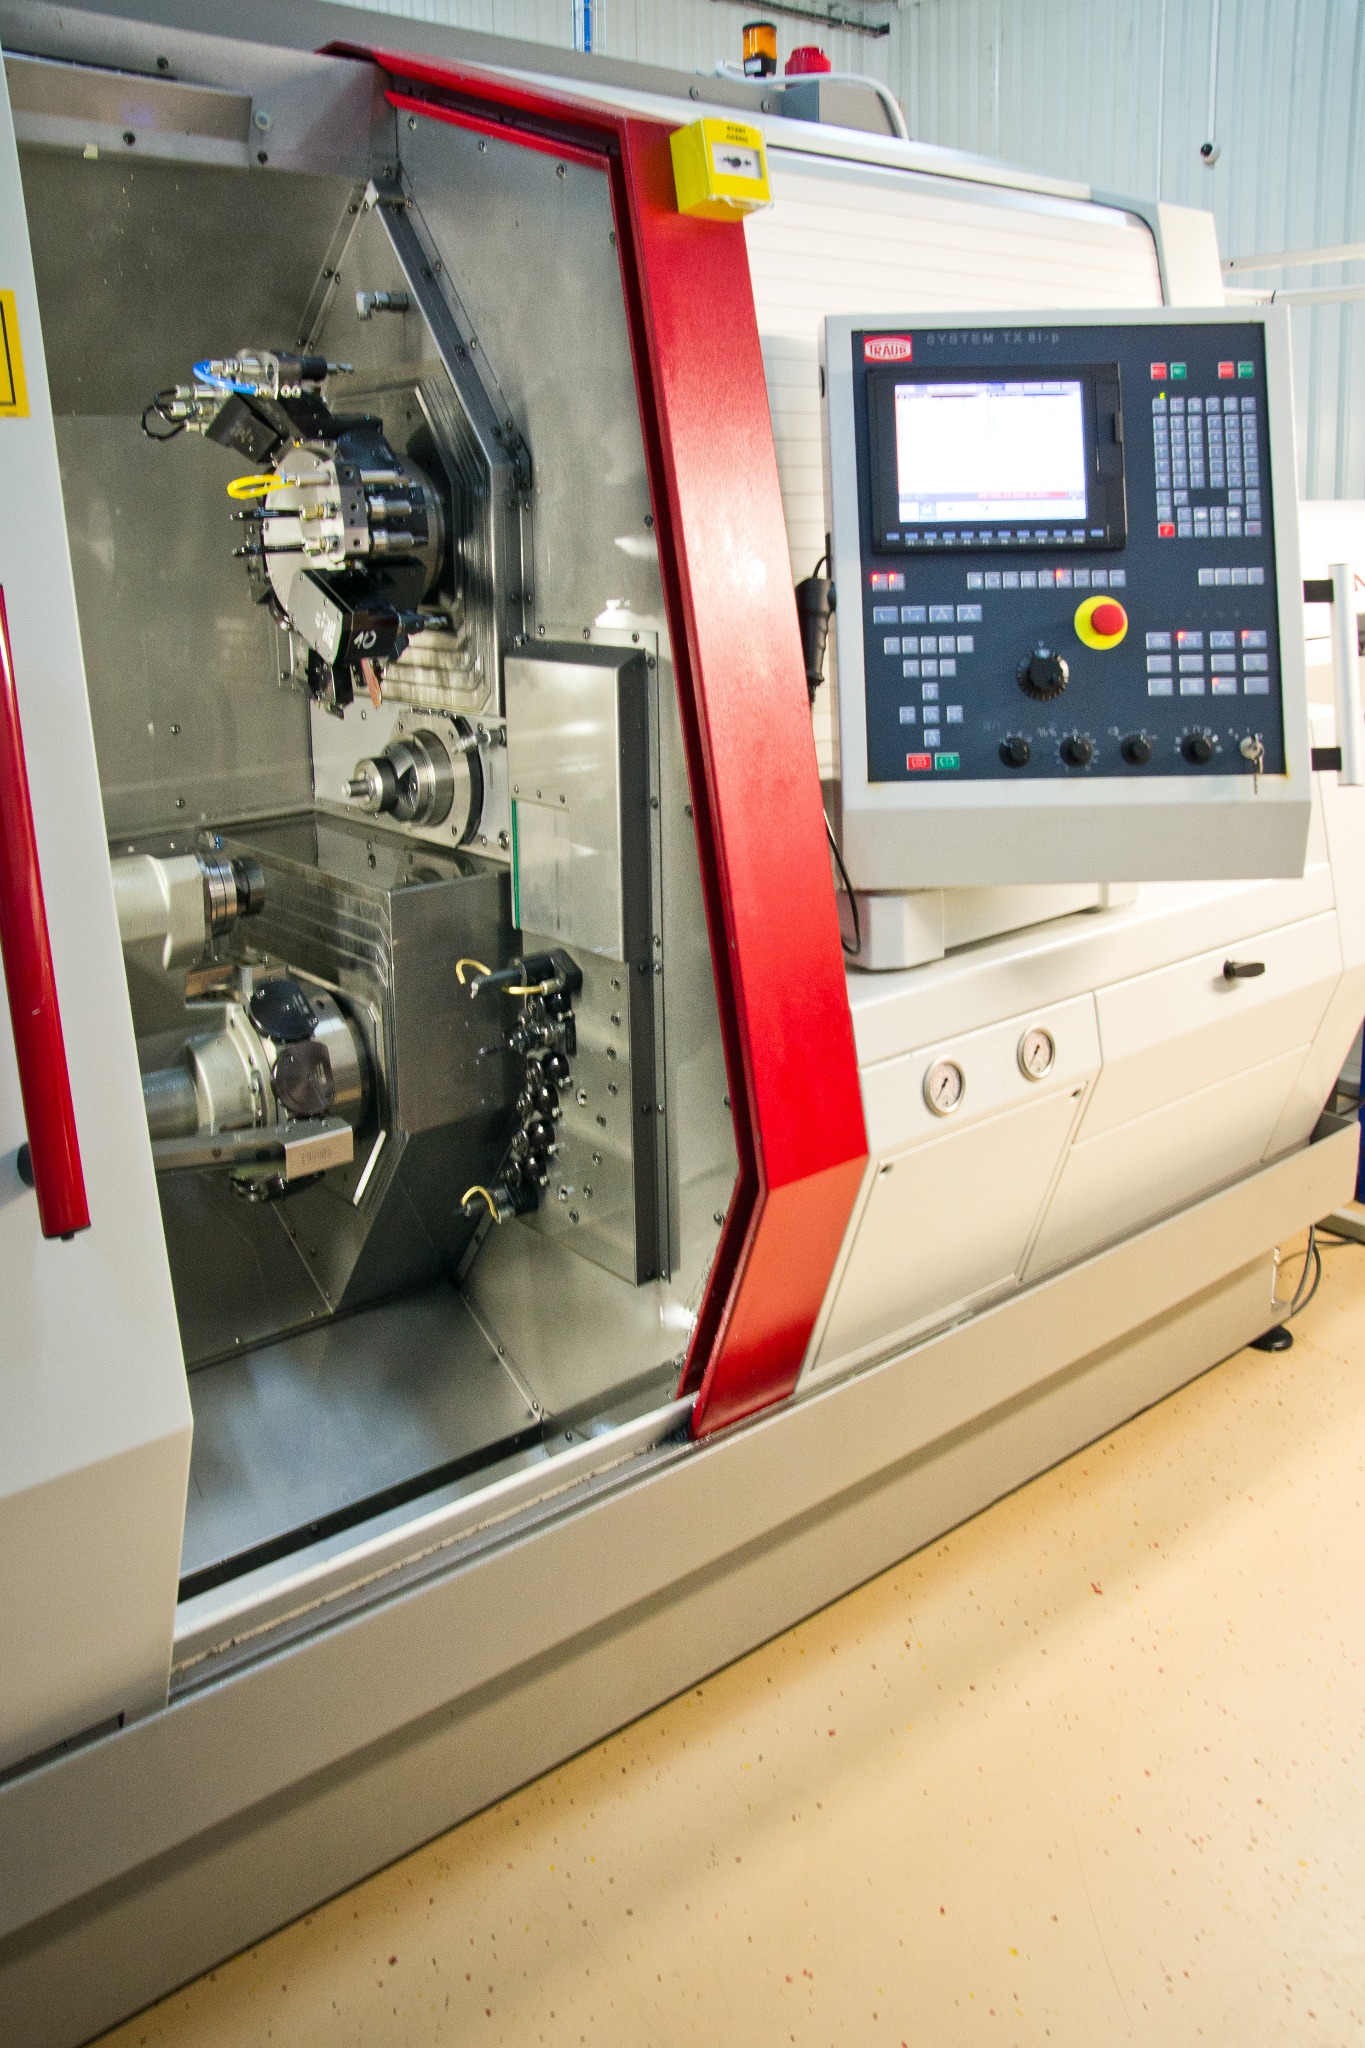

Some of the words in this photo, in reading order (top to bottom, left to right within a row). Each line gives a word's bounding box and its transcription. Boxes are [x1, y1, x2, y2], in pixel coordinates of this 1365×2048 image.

[926, 332, 994, 345] SYSTEM
[1002, 331, 1022, 344] TX
[353, 630, 377, 650] 10
